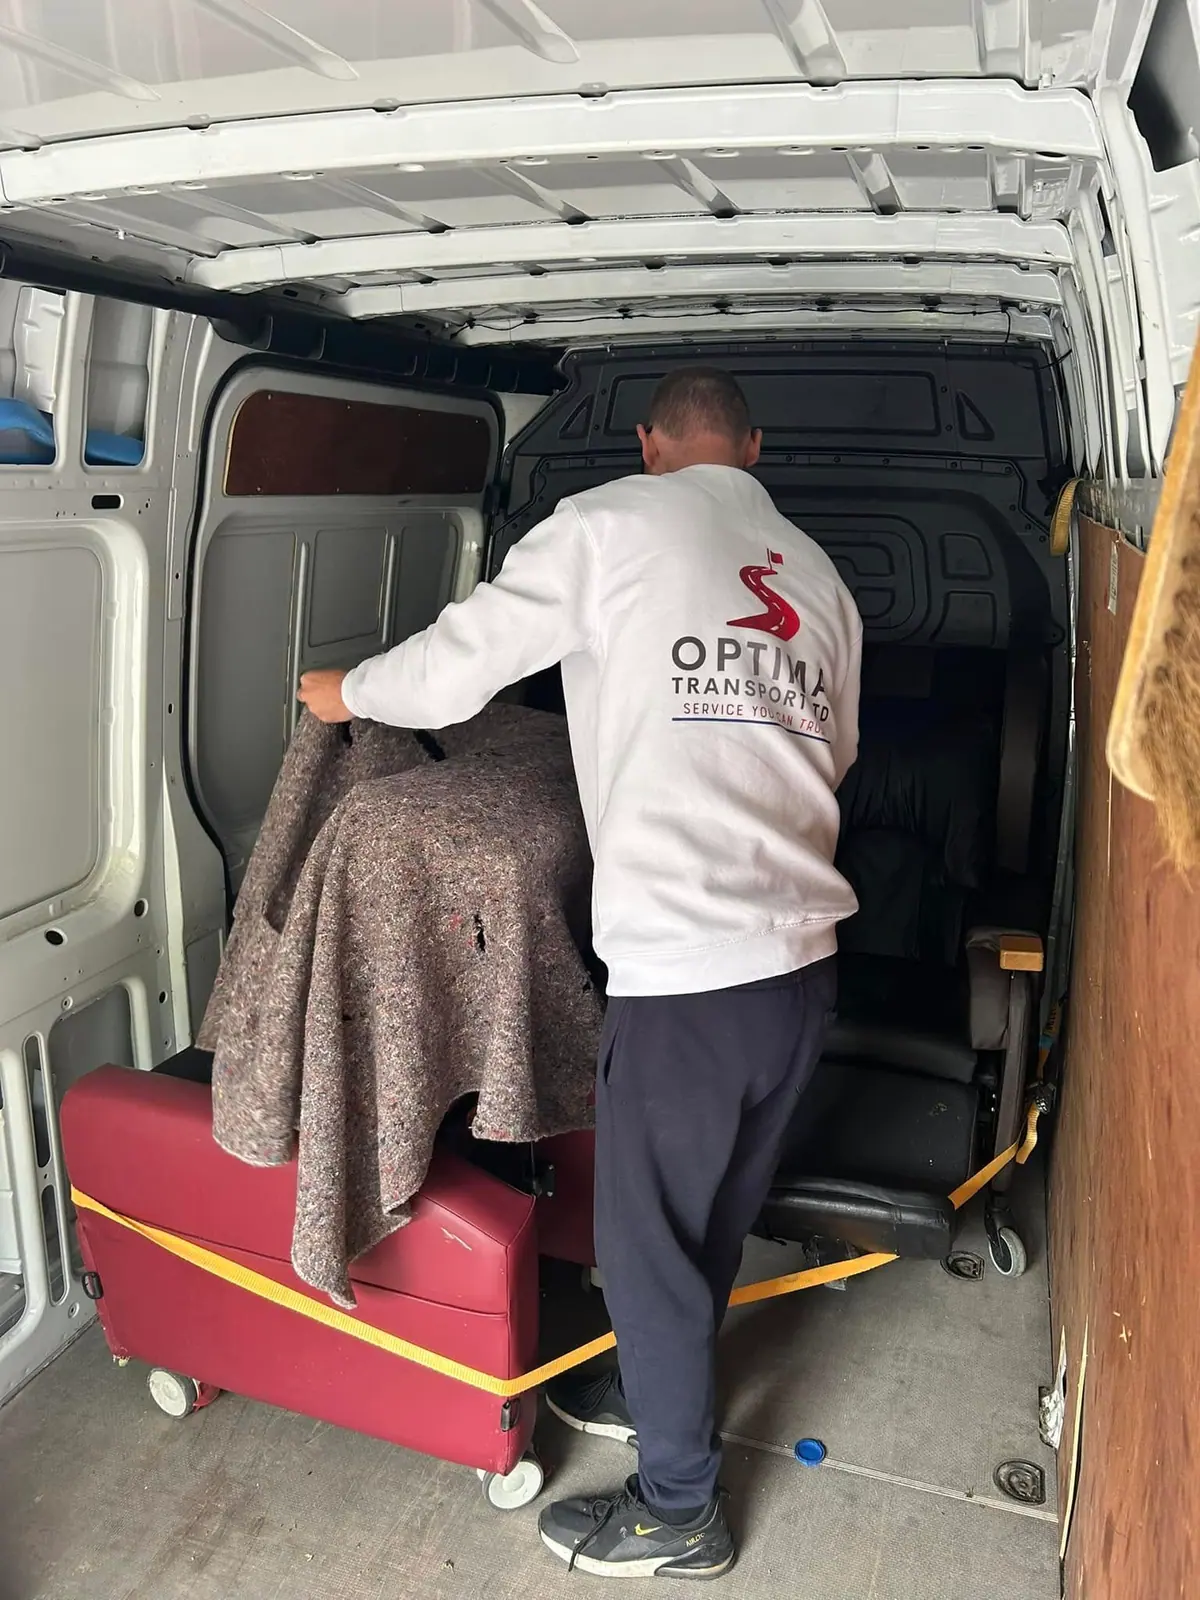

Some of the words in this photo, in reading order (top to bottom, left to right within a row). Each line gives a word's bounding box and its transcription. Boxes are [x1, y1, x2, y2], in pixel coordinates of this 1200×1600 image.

[672, 636, 825, 697] OPTIMA
[672, 677, 806, 710] TRANSPORT
[812, 702, 829, 722] TD
[683, 702, 744, 716] SERVICE
[752, 706, 774, 719] YOU
[800, 718, 825, 735] TRU
